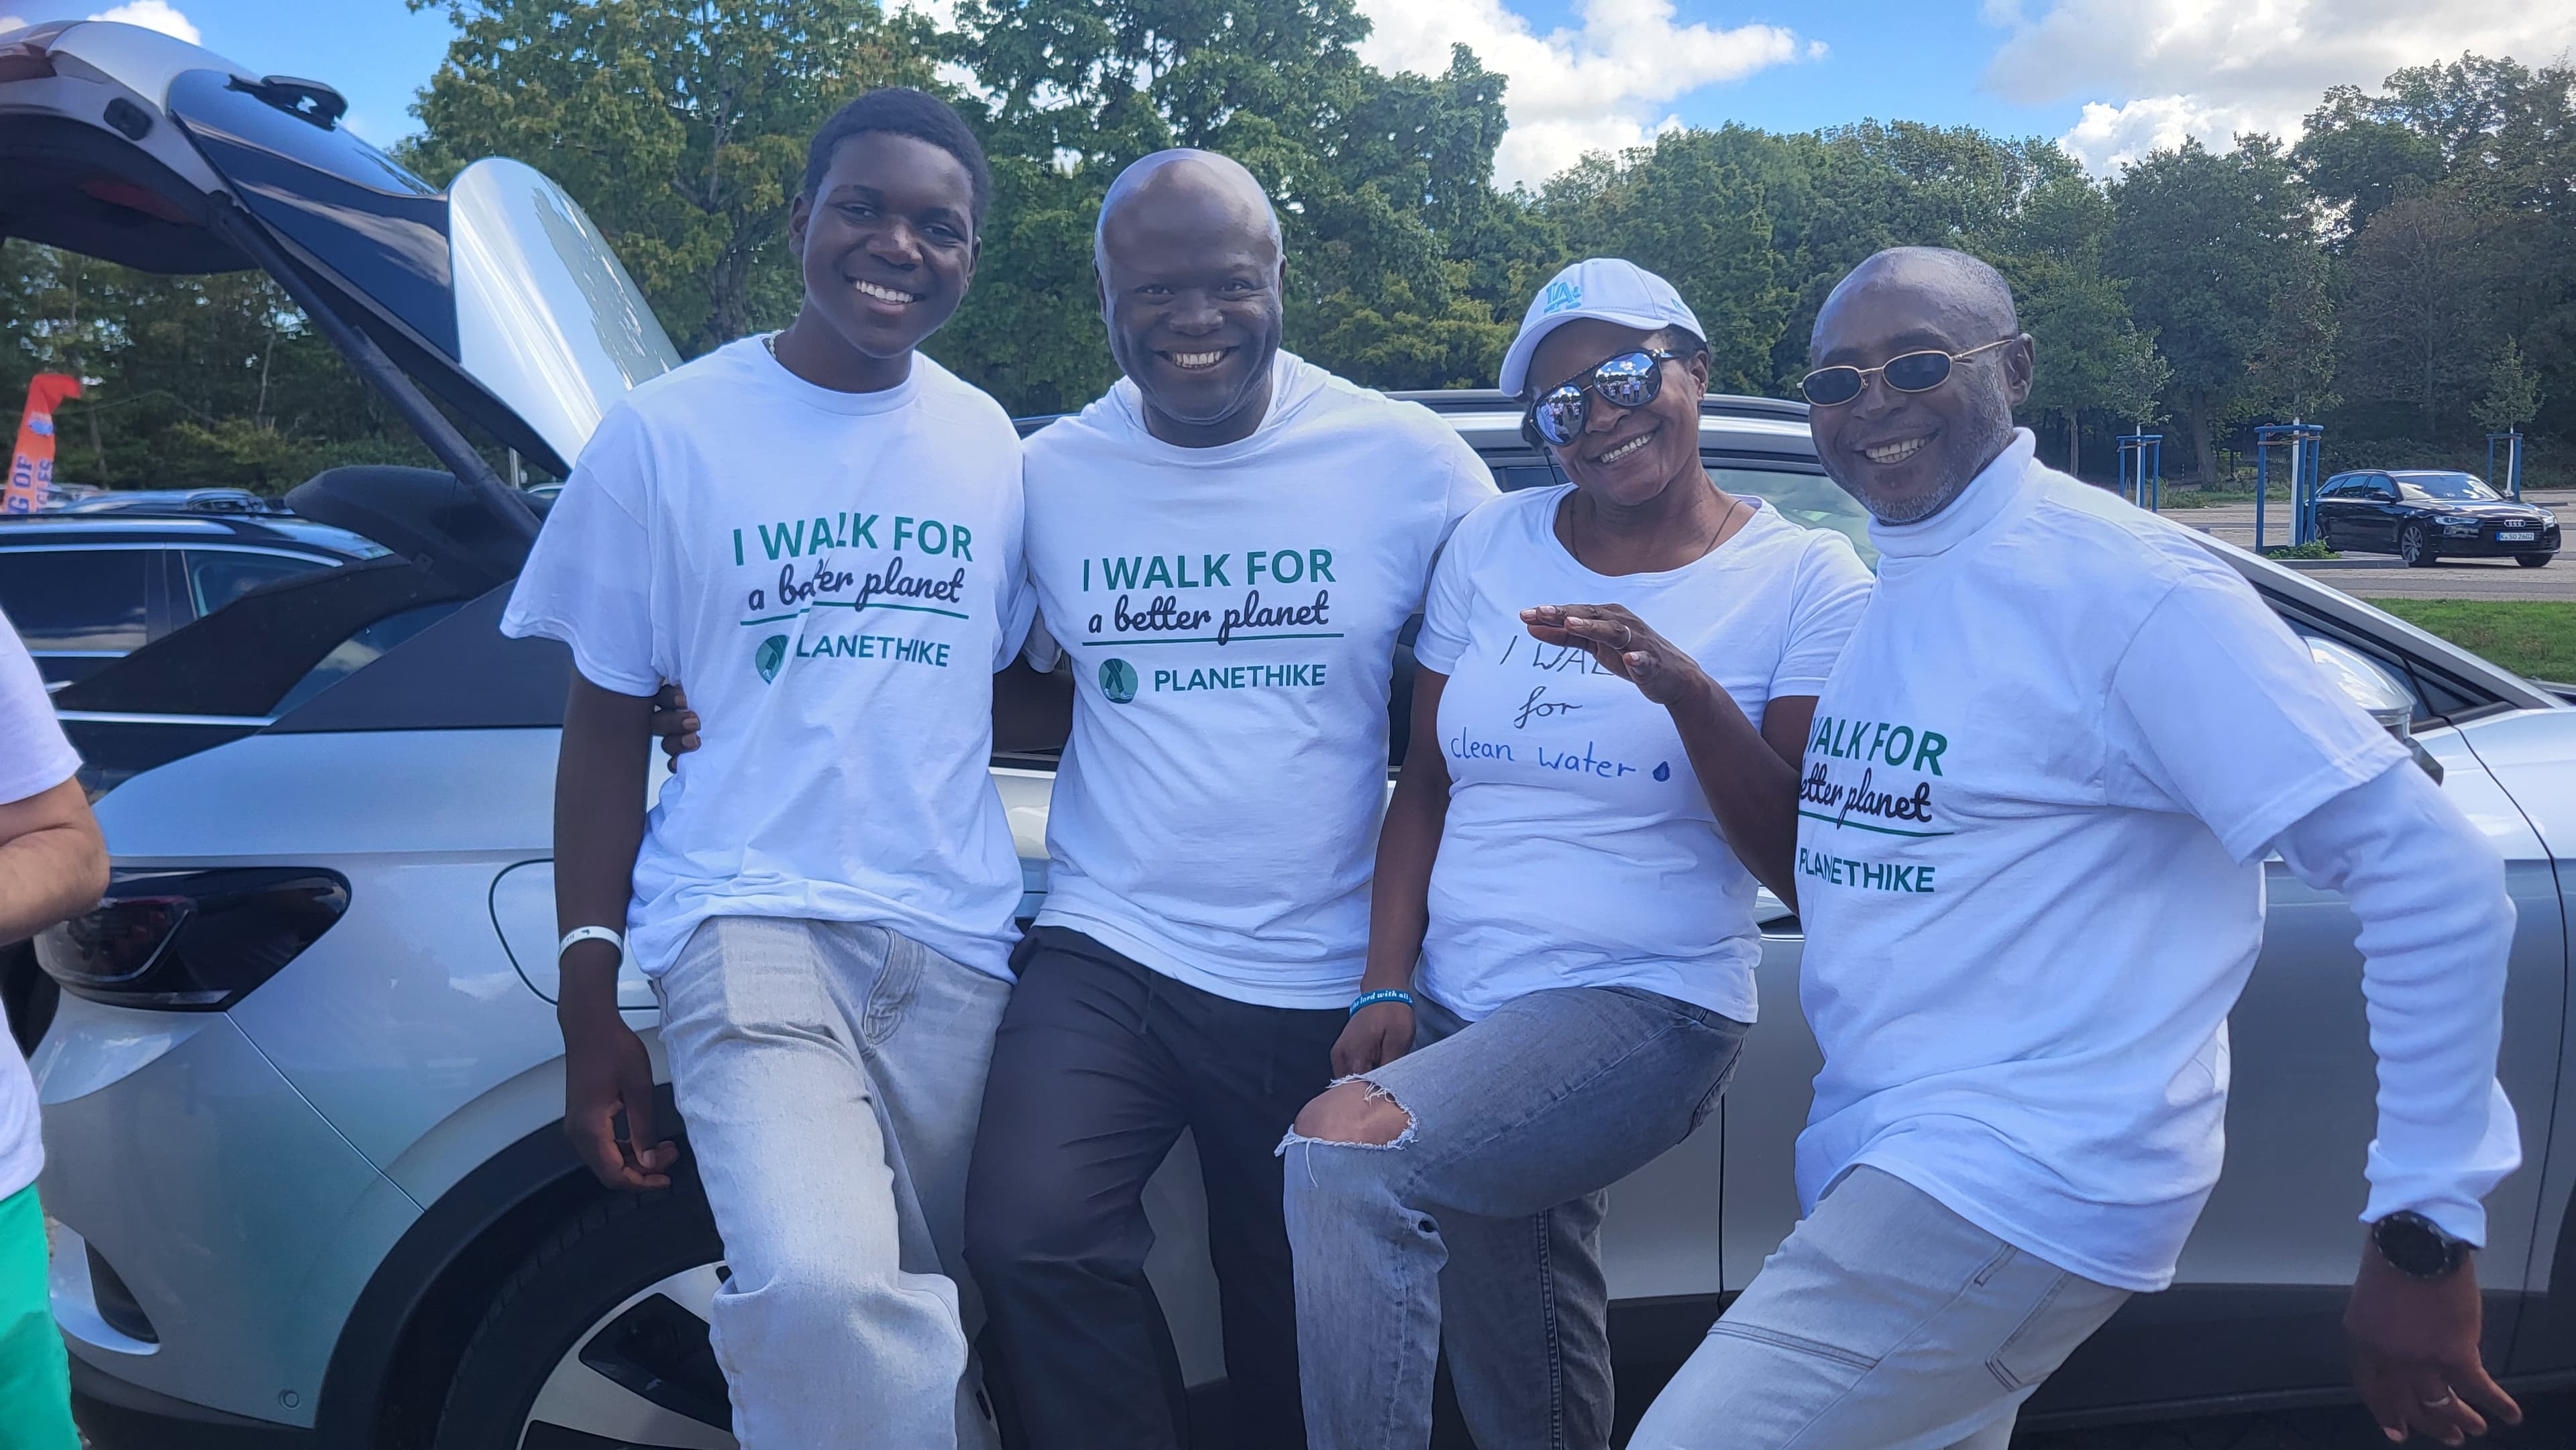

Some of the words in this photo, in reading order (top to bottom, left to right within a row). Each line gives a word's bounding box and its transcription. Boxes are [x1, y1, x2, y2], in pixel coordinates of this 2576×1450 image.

[733, 528, 745, 566] I
[758, 512, 879, 560] WALK
[894, 516, 973, 562] FOR
[749, 589, 765, 611] a
[855, 557, 965, 612] planet
[1083, 559, 1090, 592] I
[1102, 553, 1231, 590] WALK
[1247, 549, 1337, 585] FOR
[1088, 613, 1102, 633] a
[1114, 594, 1212, 632] better
[1218, 590, 1330, 646] planet
[796, 633, 951, 667] LANETHIKE
[1532, 642, 1615, 676] WAL
[1155, 664, 1327, 692] PLANETHIKE
[1513, 685, 1584, 729] for
[1450, 726, 1515, 762] clean
[1538, 740, 1637, 778] water
[1867, 722, 1948, 777] FOR
[1799, 761, 1843, 806] etter
[1837, 767, 1933, 830] planet
[1799, 847, 1935, 893] PLANETHIKE
[1360, 993, 1375, 1003] lord
